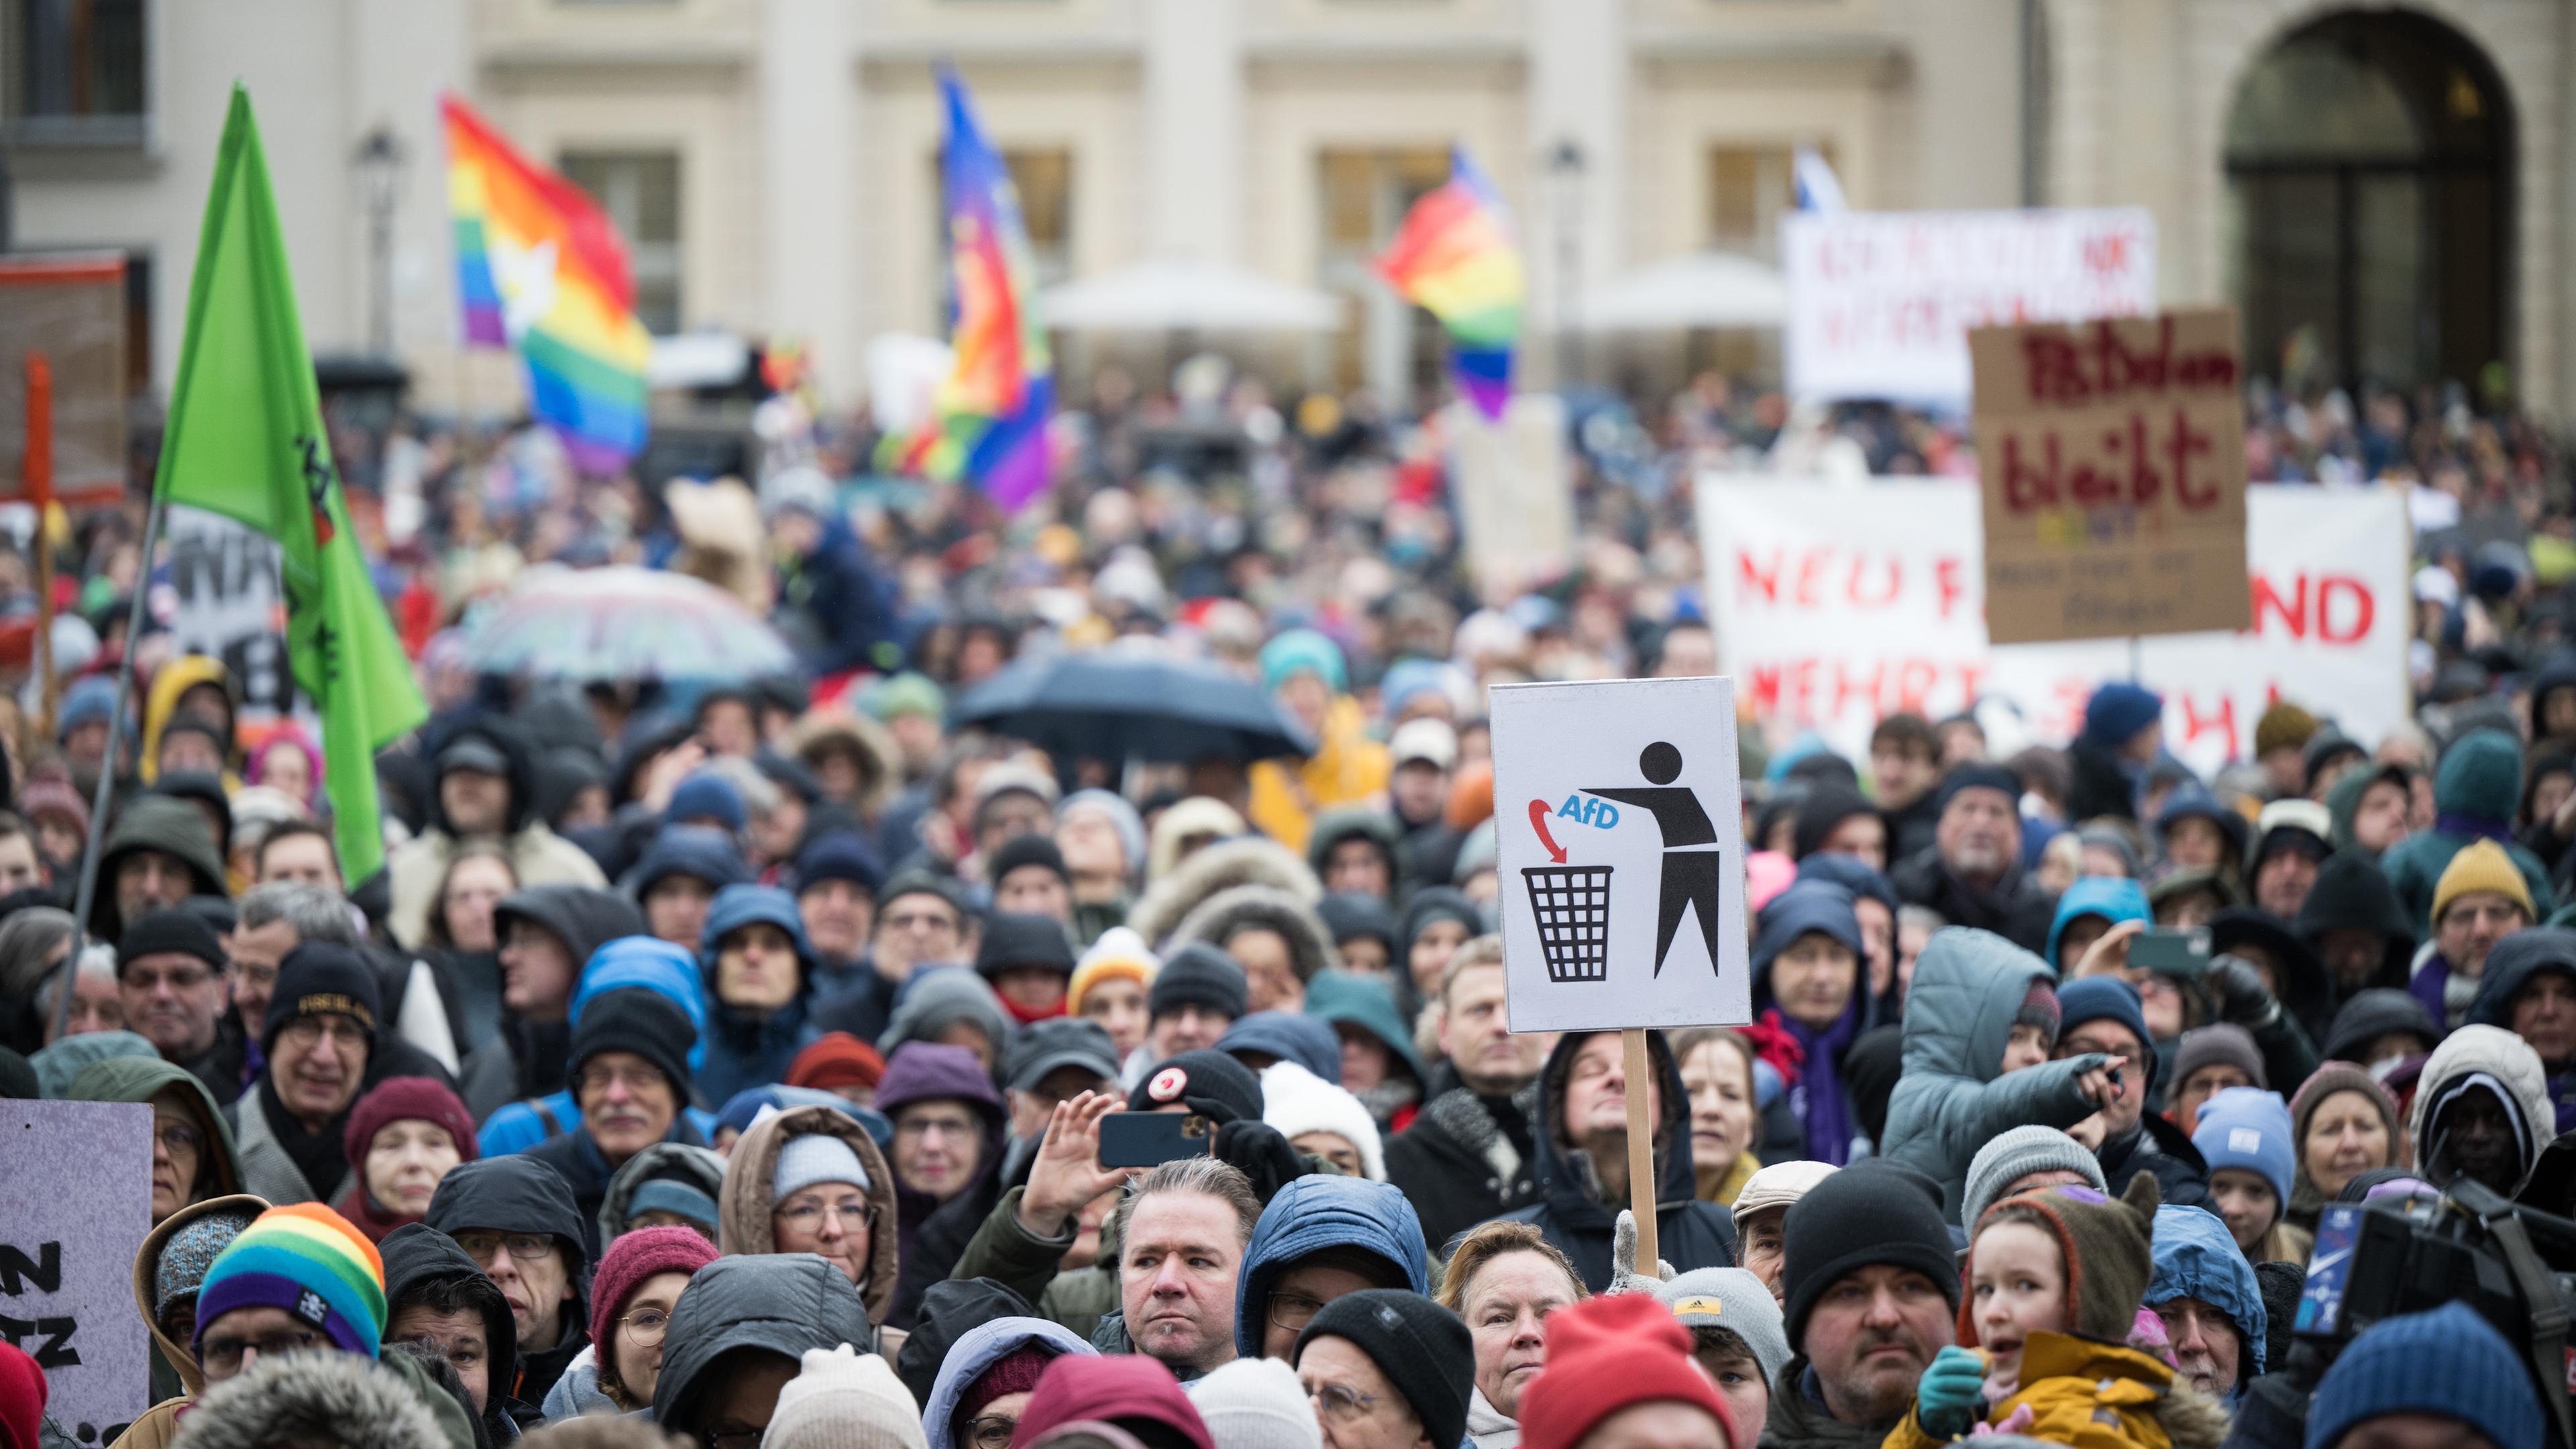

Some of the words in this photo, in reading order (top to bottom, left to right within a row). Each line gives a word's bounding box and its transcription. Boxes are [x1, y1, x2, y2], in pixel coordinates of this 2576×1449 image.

[2003, 404, 2220, 517] bleibt
[1735, 545, 1903, 608] NEU
[1557, 795, 1619, 829] AfD
